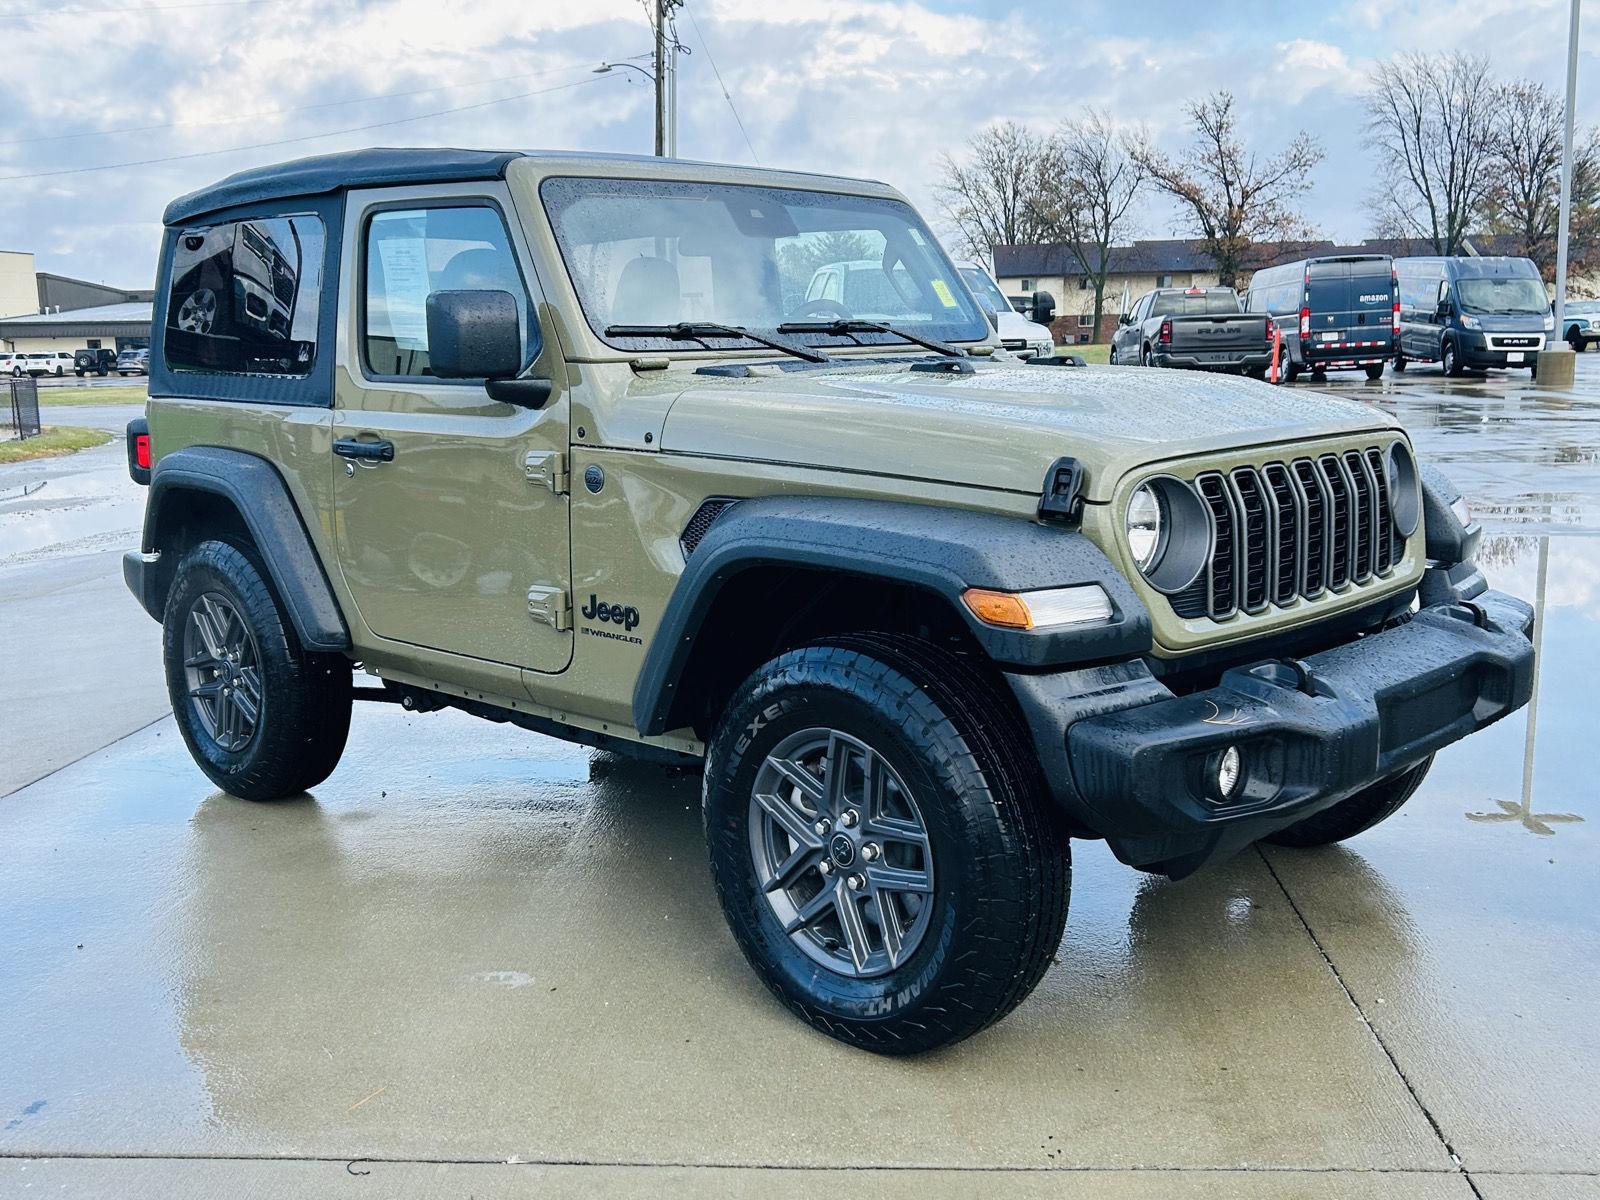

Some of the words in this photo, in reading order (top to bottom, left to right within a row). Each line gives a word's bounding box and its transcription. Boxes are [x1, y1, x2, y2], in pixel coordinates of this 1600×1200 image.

[1359, 294, 1389, 302] amazon
[581, 593, 640, 632] Jeep
[589, 628, 643, 645] WRANGLER
